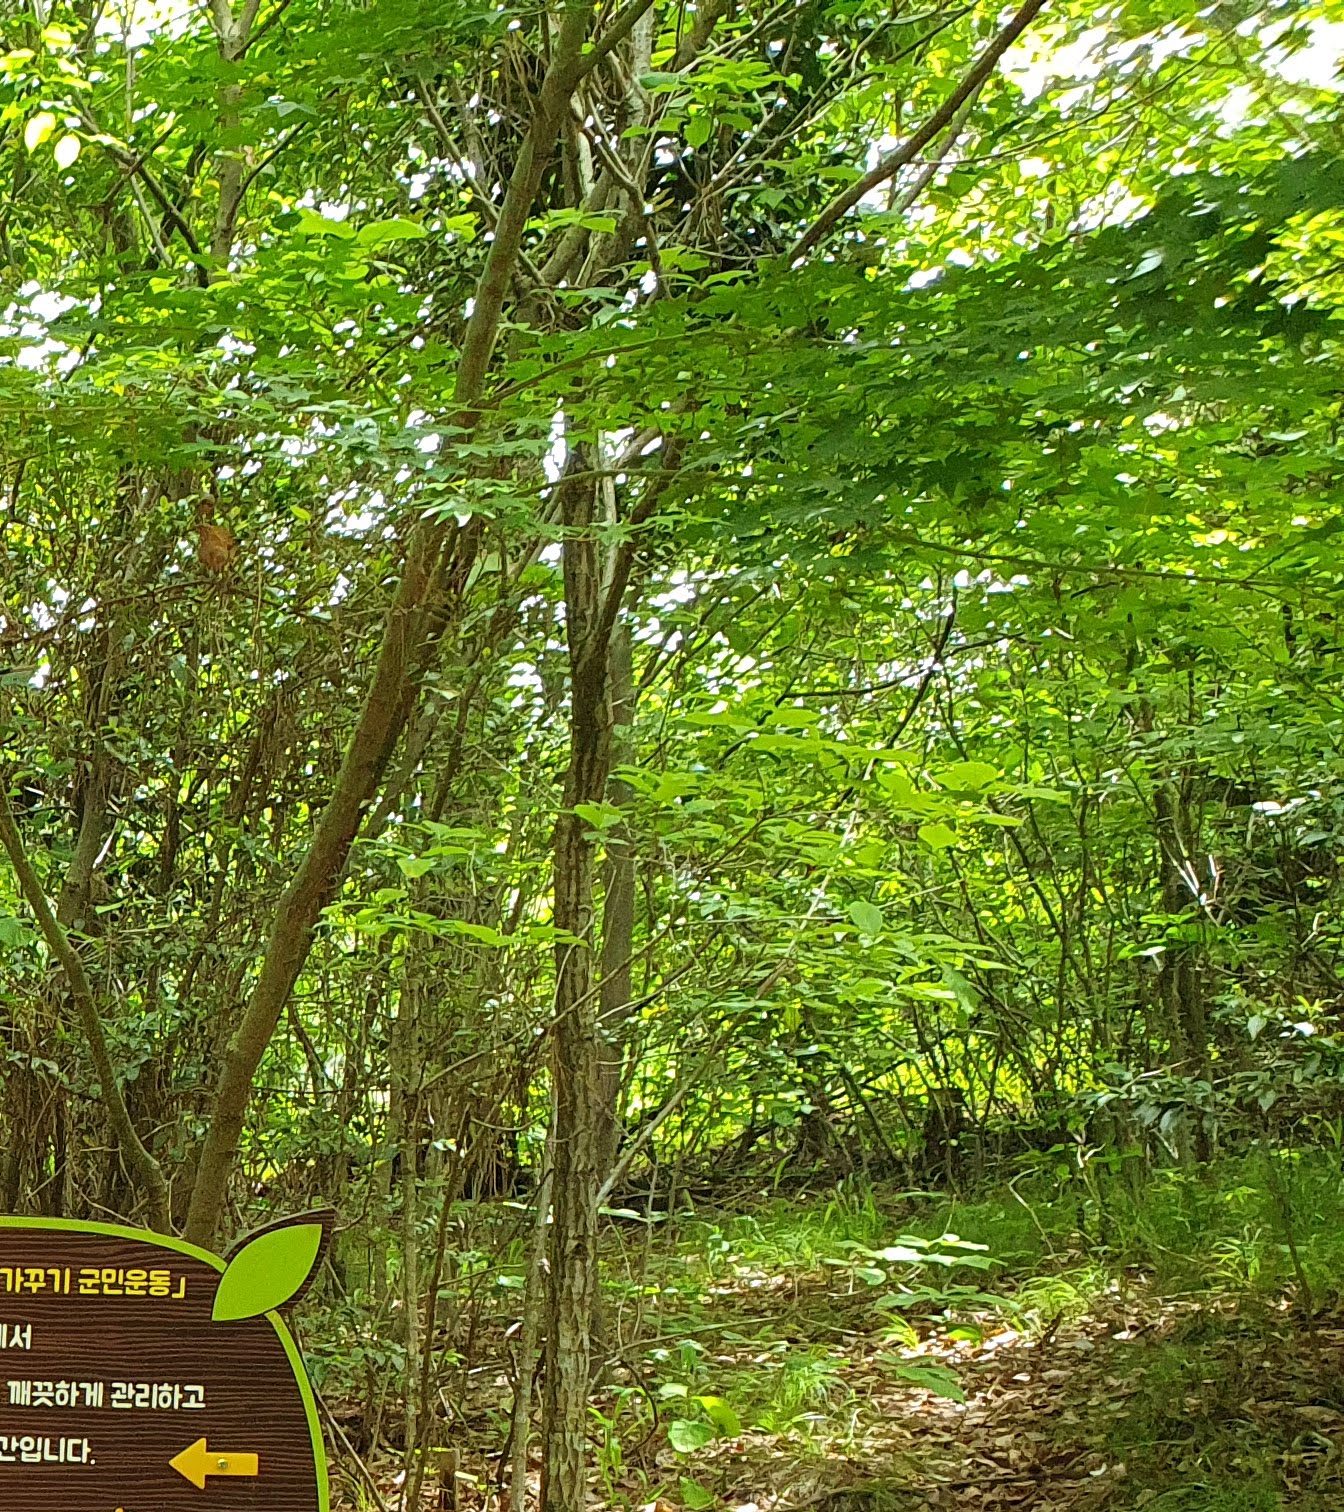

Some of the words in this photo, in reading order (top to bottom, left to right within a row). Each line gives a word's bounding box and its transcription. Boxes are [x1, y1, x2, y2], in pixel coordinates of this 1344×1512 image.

[0, 1267, 71, 1294] 가꾸기
[78, 1268, 187, 1298] 군민운동」
[7, 1380, 104, 1407] 깨끗하게
[110, 1382, 206, 1409] 관리하고
